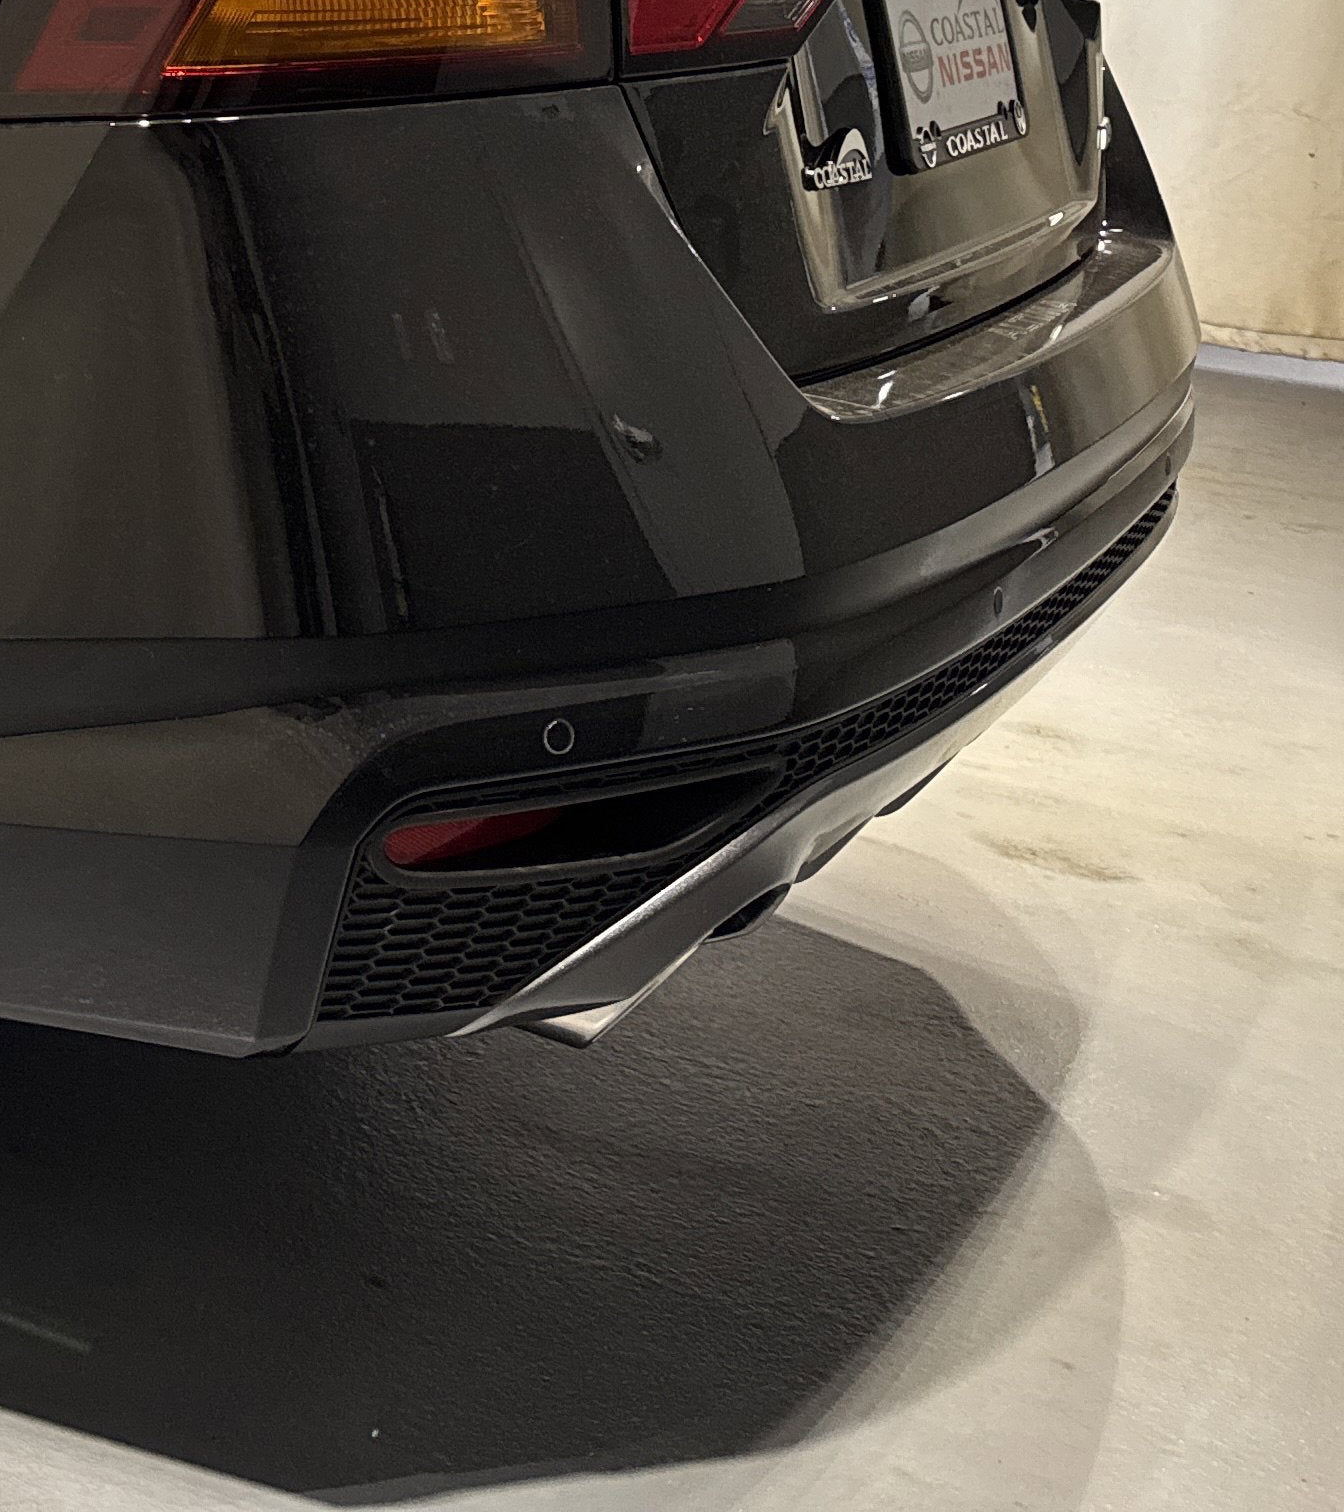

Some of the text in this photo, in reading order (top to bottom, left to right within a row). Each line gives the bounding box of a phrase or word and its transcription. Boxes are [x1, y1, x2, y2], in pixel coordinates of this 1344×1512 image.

[930, 5, 1006, 46] COASTAL
[936, 42, 1012, 88] NISSAN
[946, 120, 1009, 157] COASTAL
[813, 157, 873, 190] COASTAL
